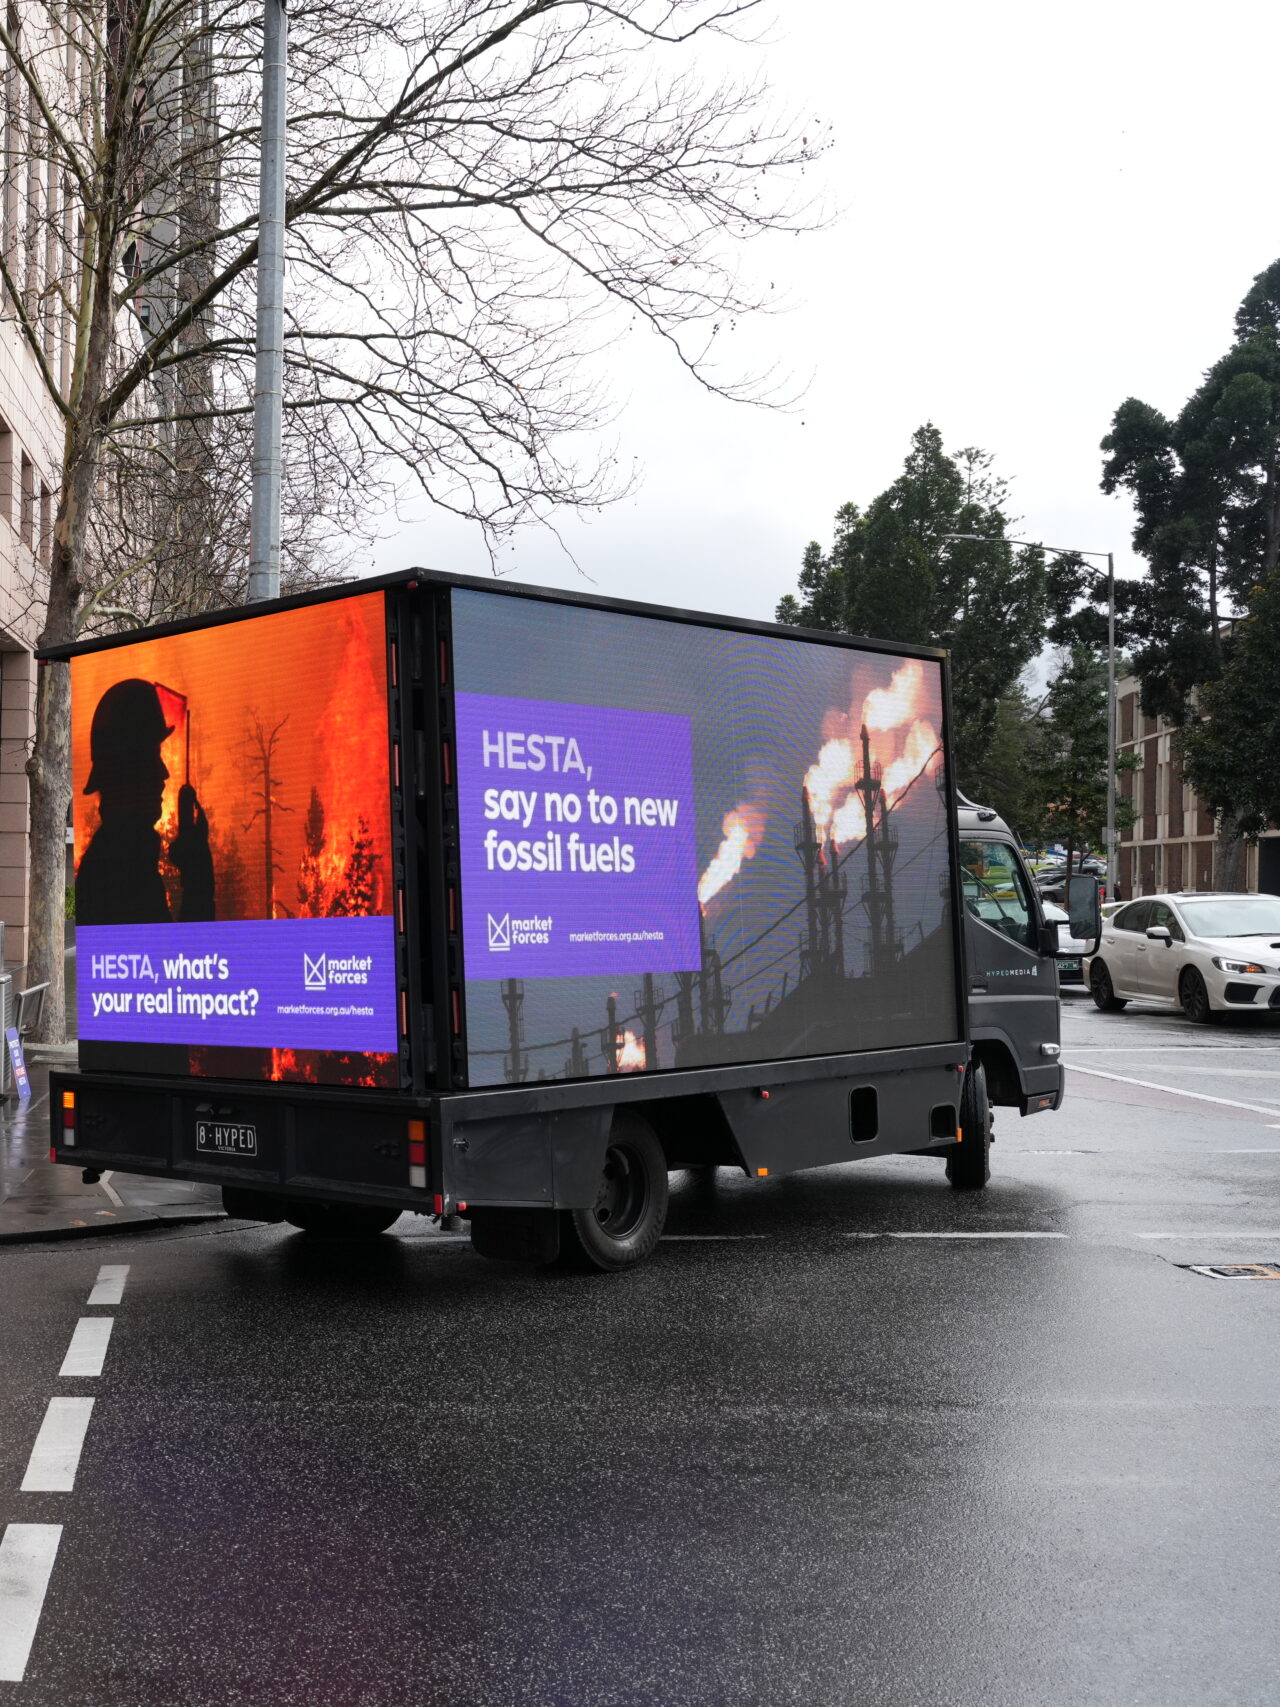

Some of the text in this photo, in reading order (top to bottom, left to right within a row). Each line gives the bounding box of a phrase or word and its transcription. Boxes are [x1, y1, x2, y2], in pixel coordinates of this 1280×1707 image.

[483, 730, 592, 781] HESTA,
[484, 788, 678, 828] say no to new
[484, 829, 635, 873] fossil fuels
[512, 915, 552, 931] market
[512, 930, 549, 944] forces
[569, 931, 664, 943] marketforces.org.au/hesta
[92, 953, 229, 984] HESTA, what's
[328, 955, 372, 970] market
[328, 970, 368, 984] forces
[91, 986, 259, 1020] your real impact?
[277, 1004, 374, 1016] marketforces.org.au/hesta
